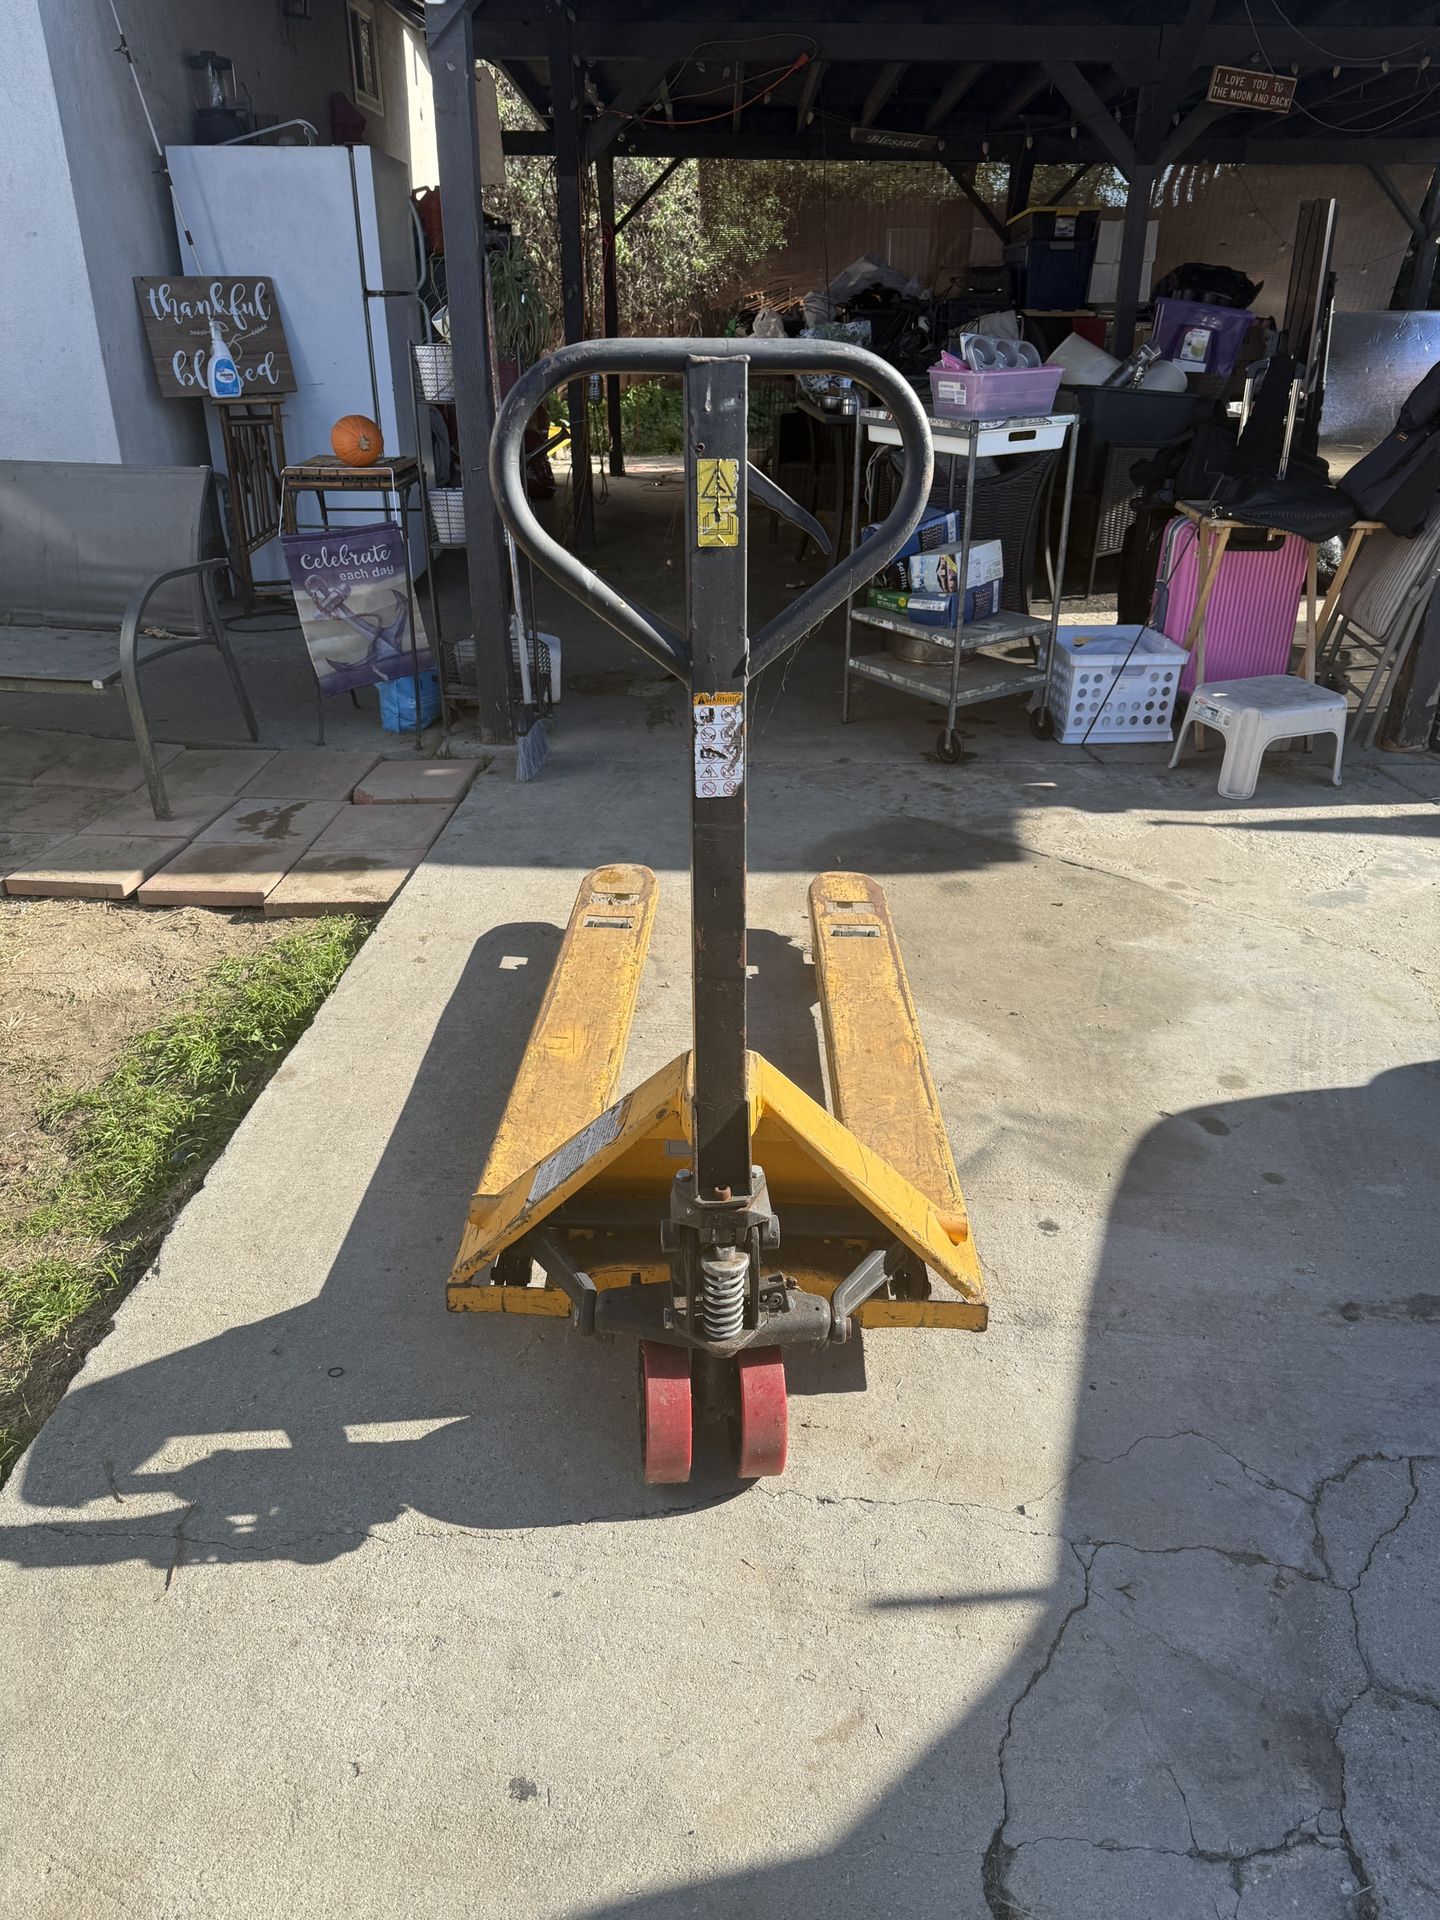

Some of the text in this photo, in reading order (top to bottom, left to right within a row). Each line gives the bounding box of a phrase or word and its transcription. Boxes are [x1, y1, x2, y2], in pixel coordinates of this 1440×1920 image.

[1224, 74, 1246, 87] LOVE
[1252, 78, 1269, 90] YOU
[1212, 86, 1290, 108] THE MOON AND BACK
[866, 135, 925, 149] Blessed
[146, 281, 271, 330] thankful
[172, 349, 280, 390] bled
[300, 543, 392, 570] Celebrate
[339, 565, 395, 581] each day
[896, 561, 909, 590] HILIPS
[706, 695, 740, 703] WARNING
